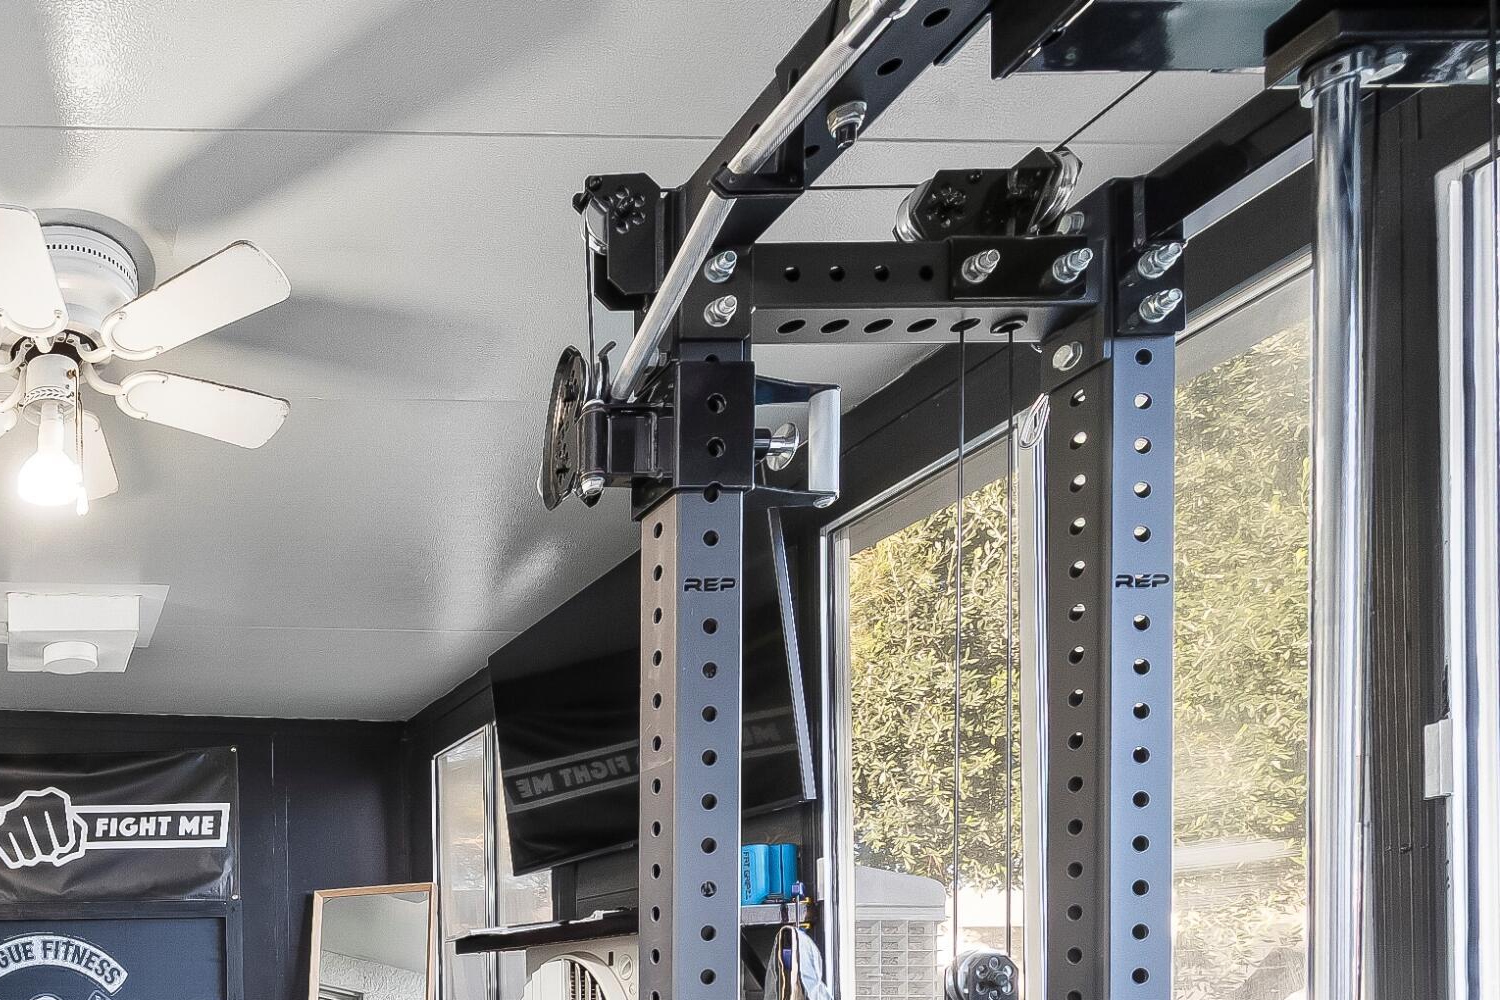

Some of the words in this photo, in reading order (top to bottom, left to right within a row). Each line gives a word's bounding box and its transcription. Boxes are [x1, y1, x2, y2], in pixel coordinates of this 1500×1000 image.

[683, 577, 736, 592] REP
[1114, 573, 1170, 588] REP
[95, 816, 172, 838] FIGHT
[177, 815, 214, 836] ME
[41, 940, 121, 985] FITNESS
